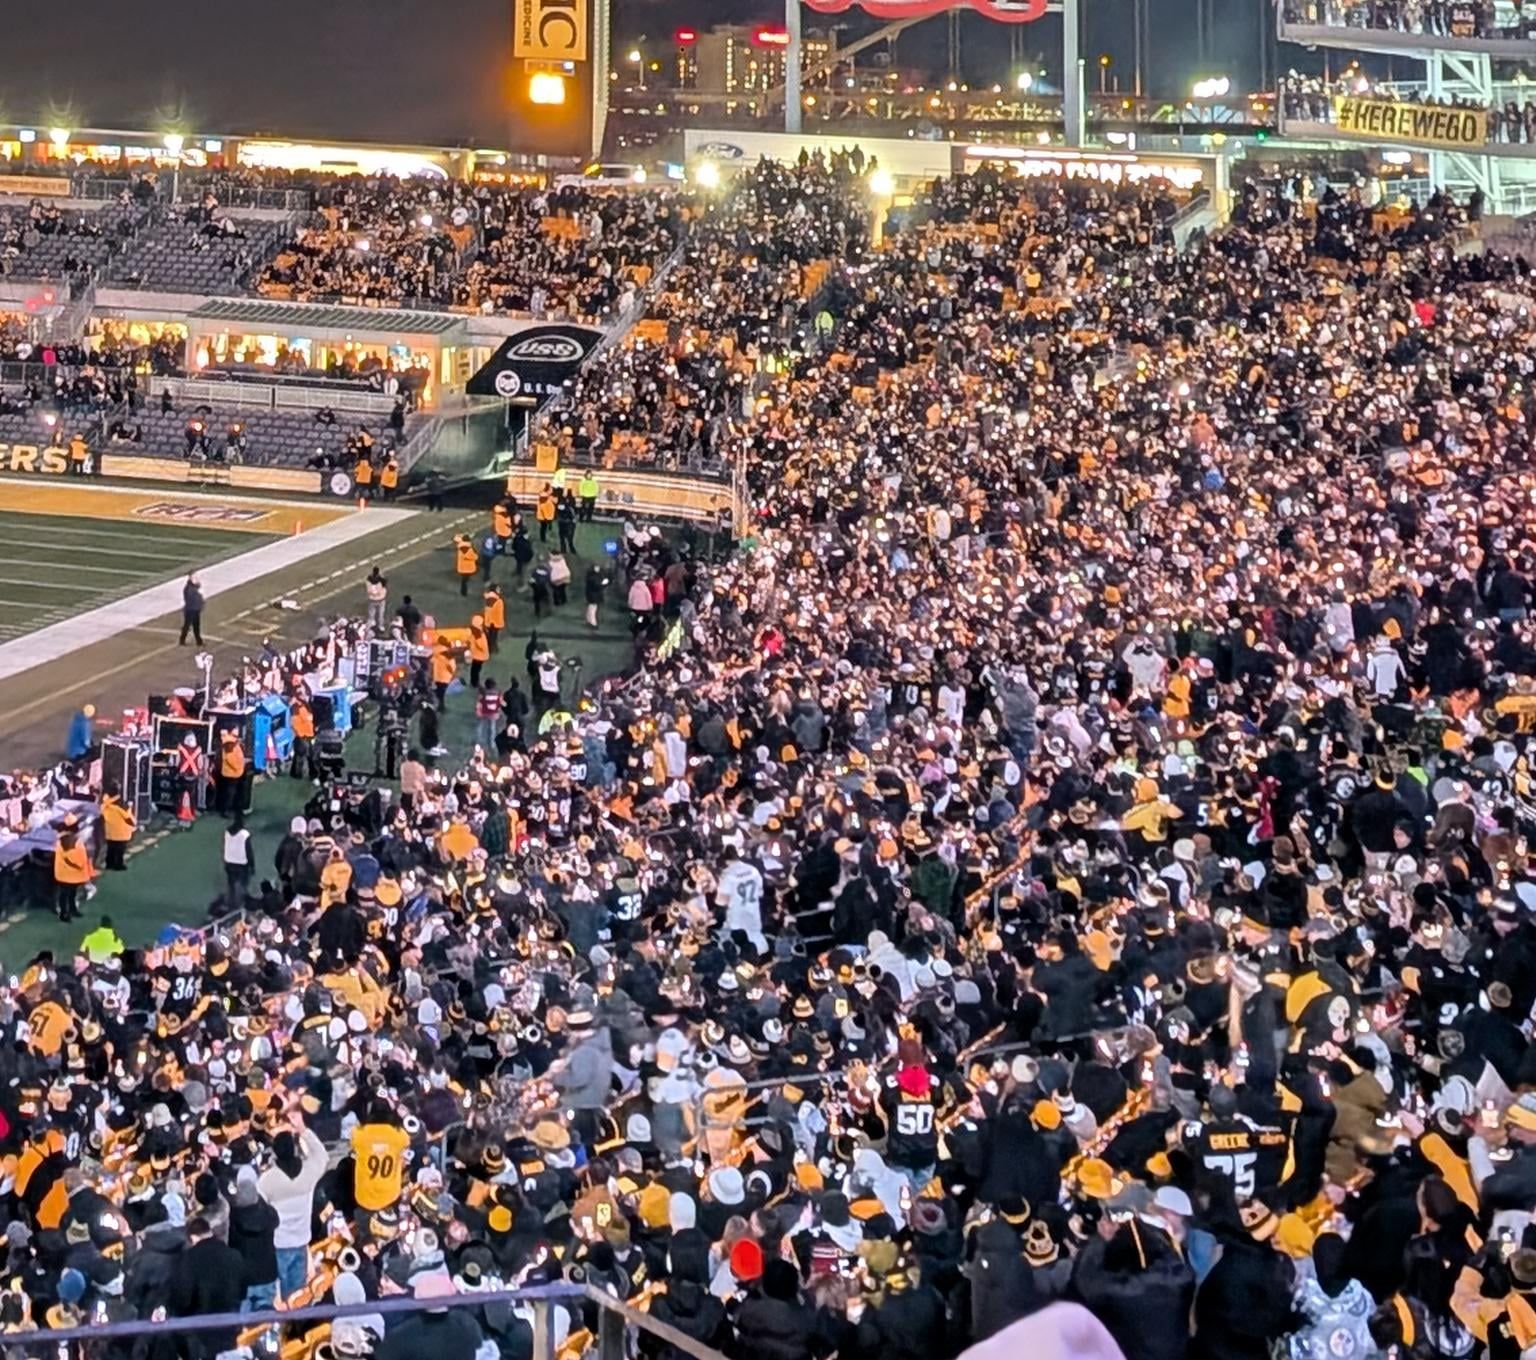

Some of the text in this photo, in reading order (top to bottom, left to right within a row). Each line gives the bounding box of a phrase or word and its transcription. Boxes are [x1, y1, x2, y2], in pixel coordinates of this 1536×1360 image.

[518, 342, 574, 356] USS
[896, 1103, 935, 1134] 50
[367, 1155, 393, 1179] 90
